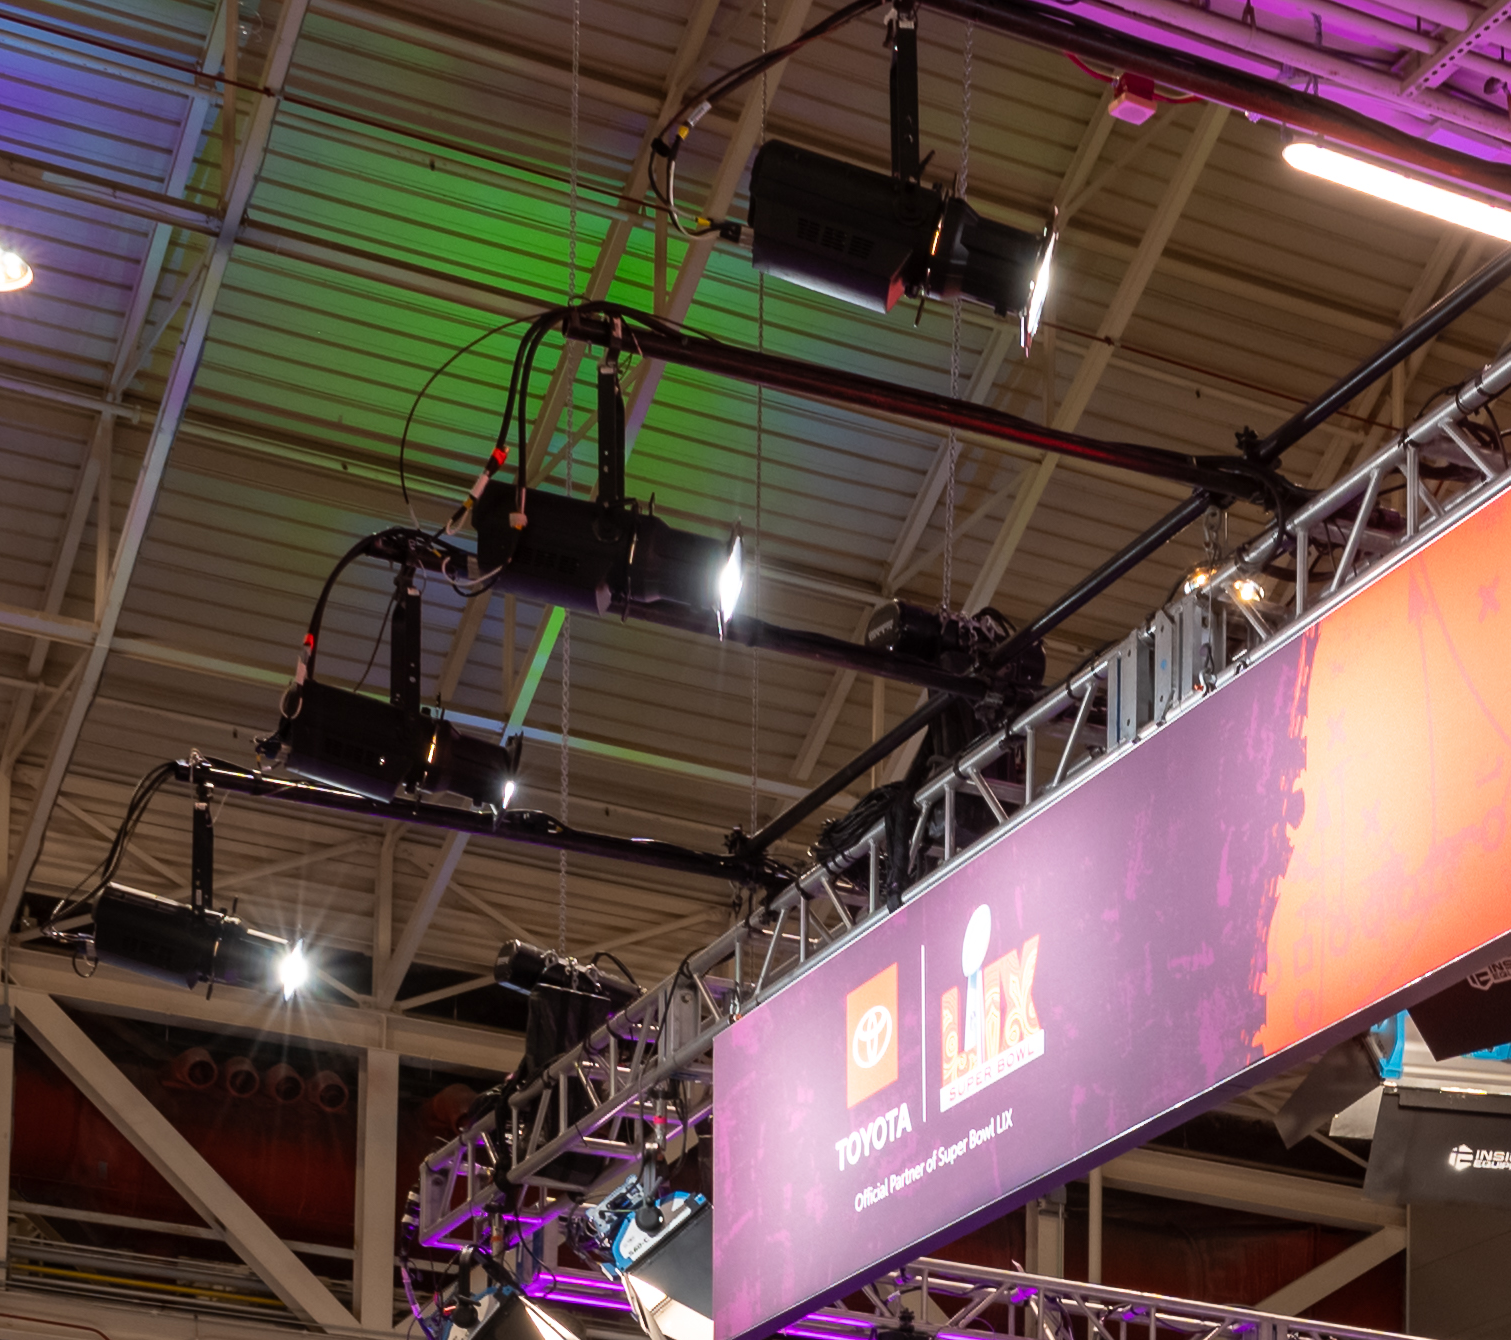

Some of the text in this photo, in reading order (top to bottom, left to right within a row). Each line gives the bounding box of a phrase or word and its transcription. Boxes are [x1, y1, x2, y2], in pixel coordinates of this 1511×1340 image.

[949, 1045, 1035, 1102] SUPER BOWL
[834, 1102, 913, 1172] TOYOTA
[854, 1107, 1014, 1213] Official Partner of Super Bowl LIX
